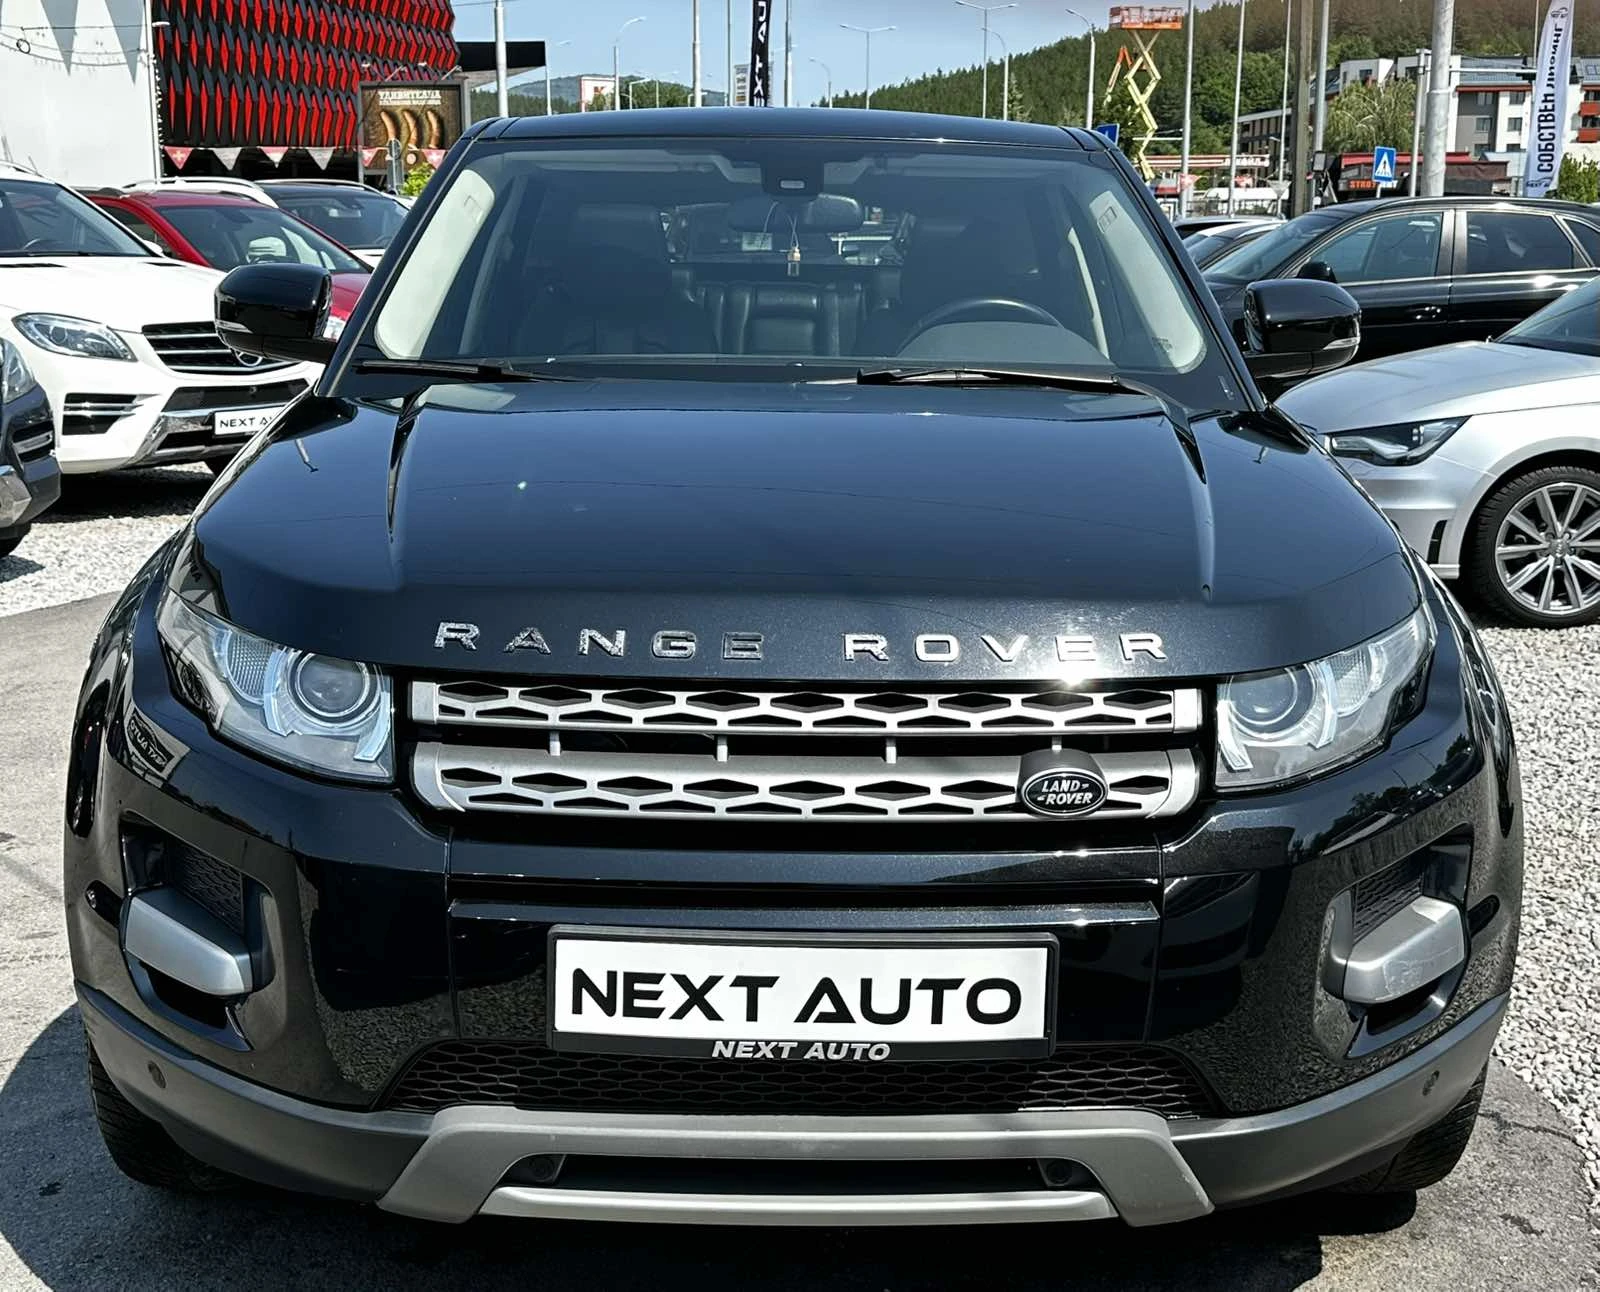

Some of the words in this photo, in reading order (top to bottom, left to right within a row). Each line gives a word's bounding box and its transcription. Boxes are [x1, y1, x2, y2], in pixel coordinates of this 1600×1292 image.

[1538, 93, 1555, 173] СОБСТВЕН
[220, 417, 256, 428] NEXT
[260, 416, 272, 425] A
[434, 622, 764, 660] RANGE
[845, 632, 1166, 662] ROVER
[1042, 780, 1081, 792] LAND
[1046, 793, 1093, 805] ROVER
[573, 968, 780, 1022] NEXT
[794, 976, 1021, 1025] AUTO
[712, 1041, 797, 1058] NEXT
[804, 1042, 890, 1061] AUTO
